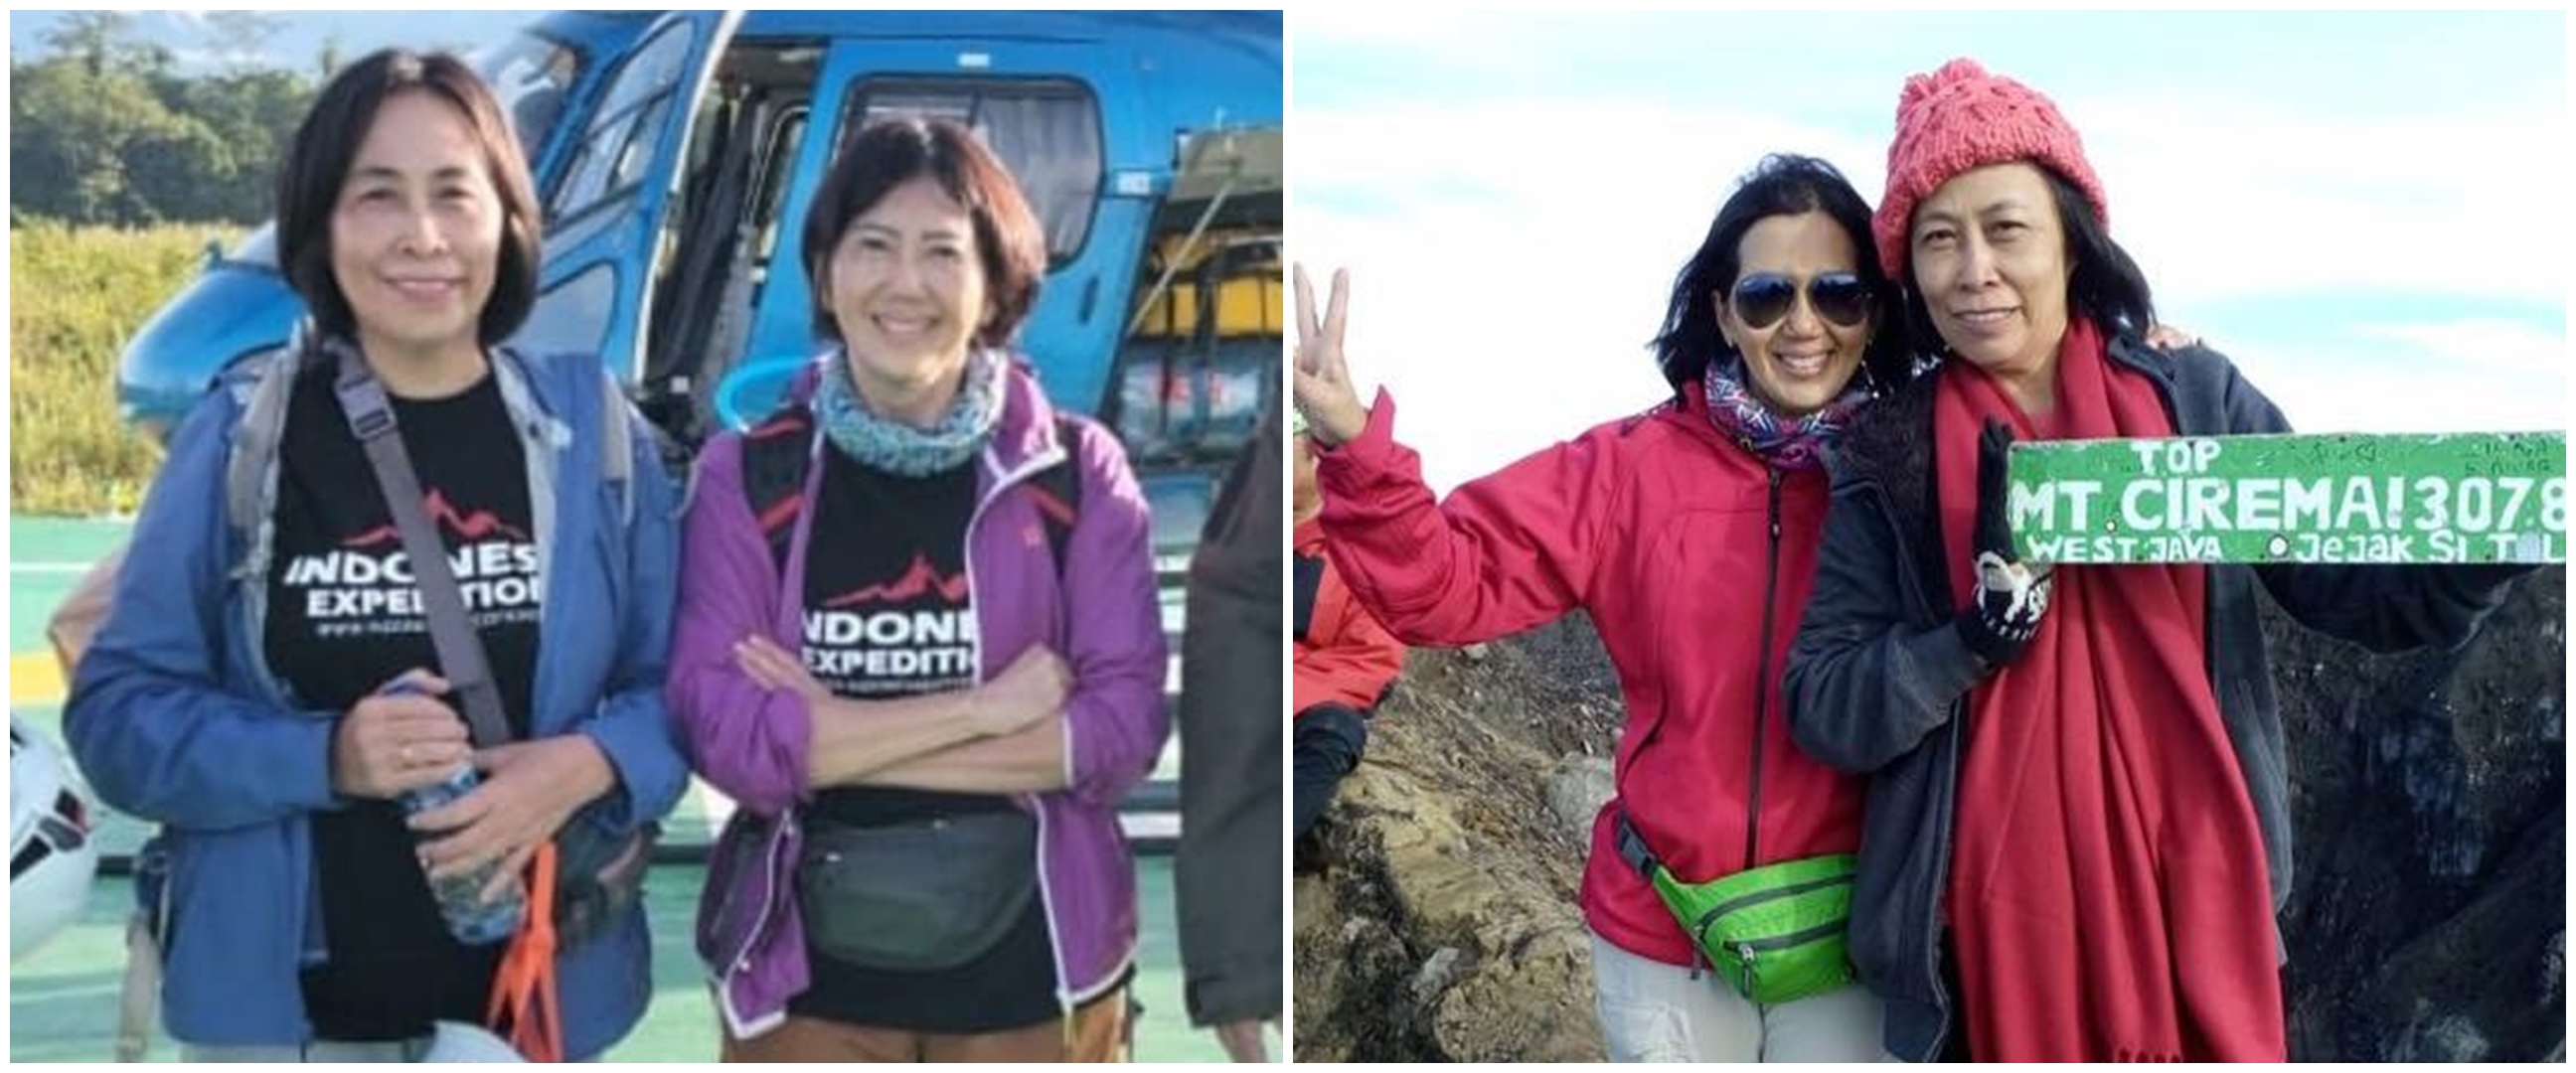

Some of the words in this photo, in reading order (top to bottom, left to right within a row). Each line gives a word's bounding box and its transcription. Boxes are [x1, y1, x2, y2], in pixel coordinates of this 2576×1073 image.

[2131, 440, 2221, 474] TOP
[2011, 479, 2102, 531] MT
[2121, 476, 2405, 531] CIREMAI
[2414, 476, 2566, 532] 3078
[2025, 536, 2137, 563] WEST
[2145, 535, 2224, 562] JAVA
[2486, 534, 2566, 563] TL
